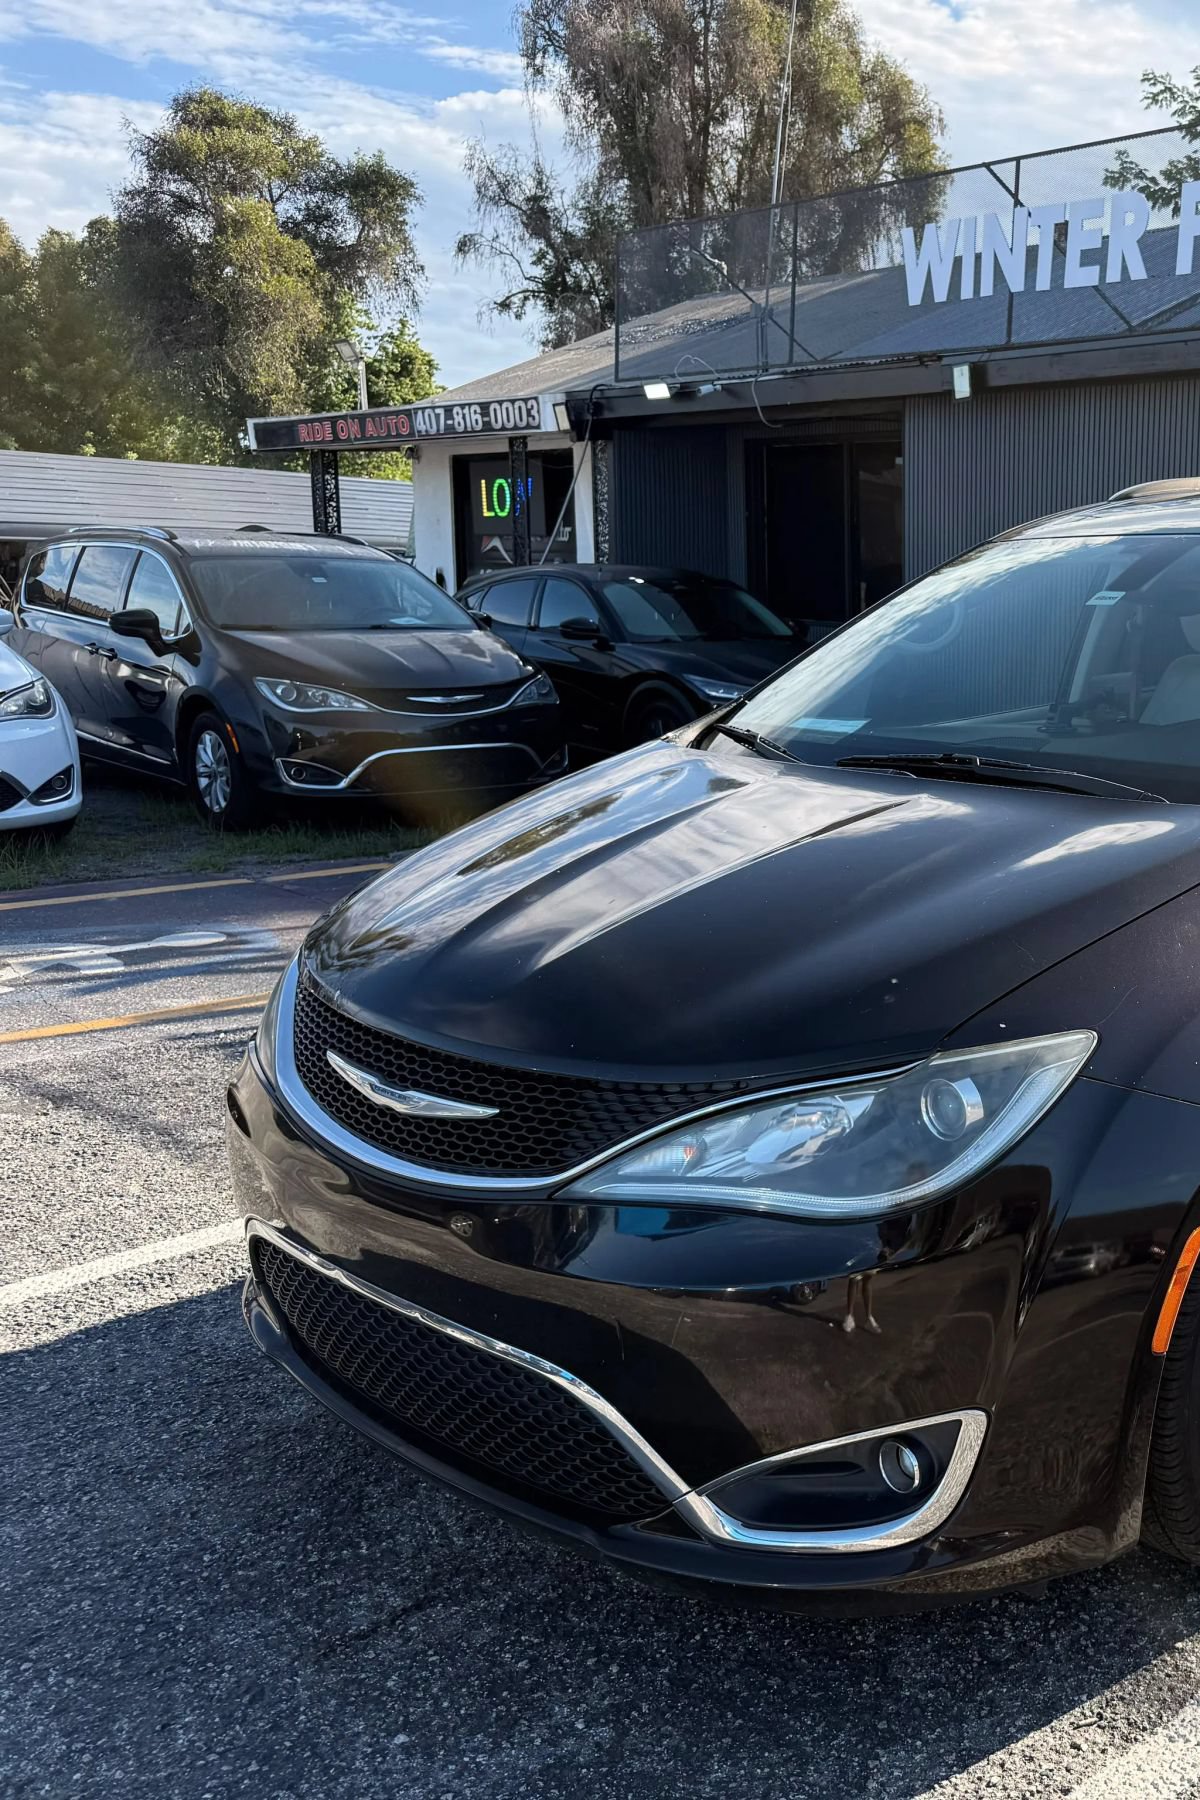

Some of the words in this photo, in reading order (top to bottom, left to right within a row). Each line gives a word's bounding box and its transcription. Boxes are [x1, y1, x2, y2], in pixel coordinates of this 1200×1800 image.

[901, 192, 1151, 307] WINTER
[298, 420, 333, 442] RIDE
[336, 418, 361, 439] ON
[365, 415, 410, 437] AUTO
[416, 399, 540, 436] 407-816-0003
